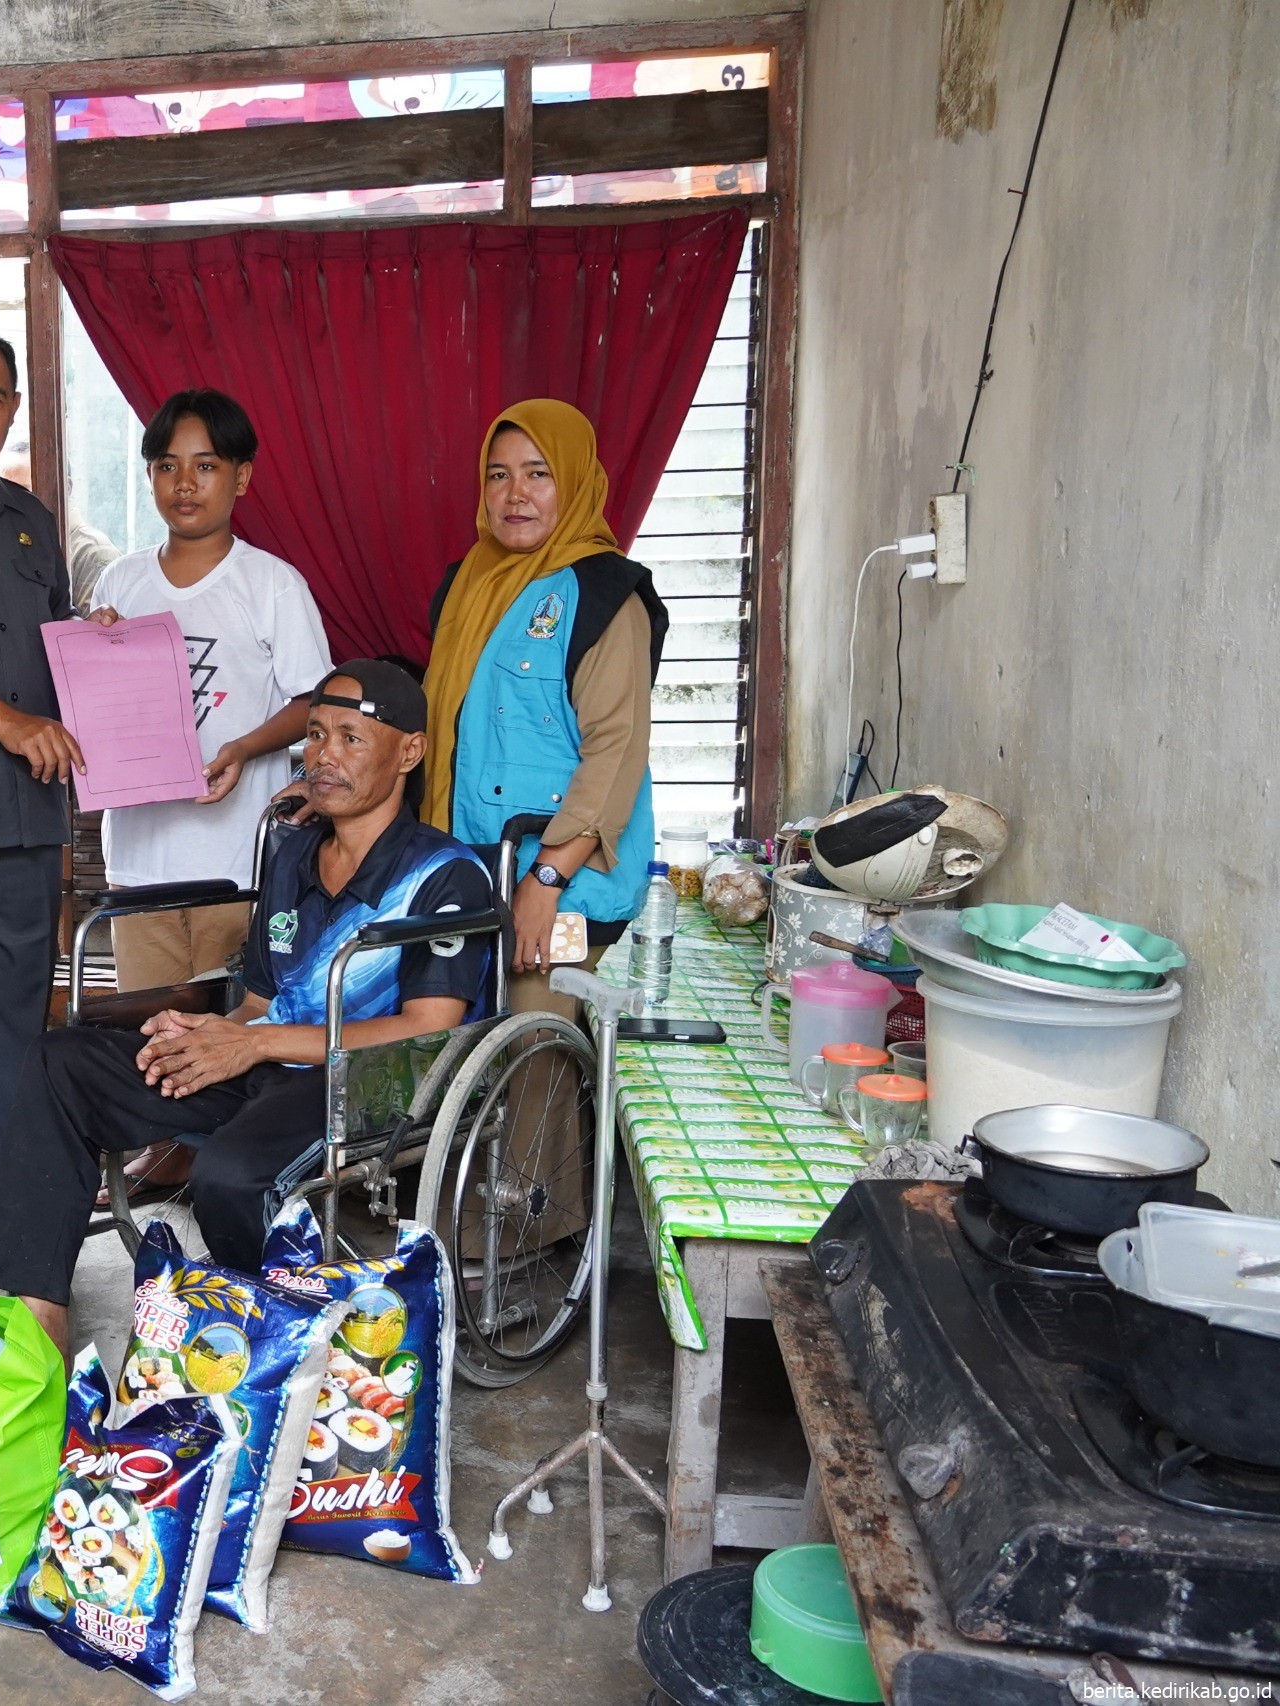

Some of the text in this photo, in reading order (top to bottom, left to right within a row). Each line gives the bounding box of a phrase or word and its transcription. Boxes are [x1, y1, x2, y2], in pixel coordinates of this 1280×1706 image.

[135, 1299, 188, 1336] UPER
[77, 1600, 145, 1634] POLES
[78, 1615, 145, 1650] SUPER
